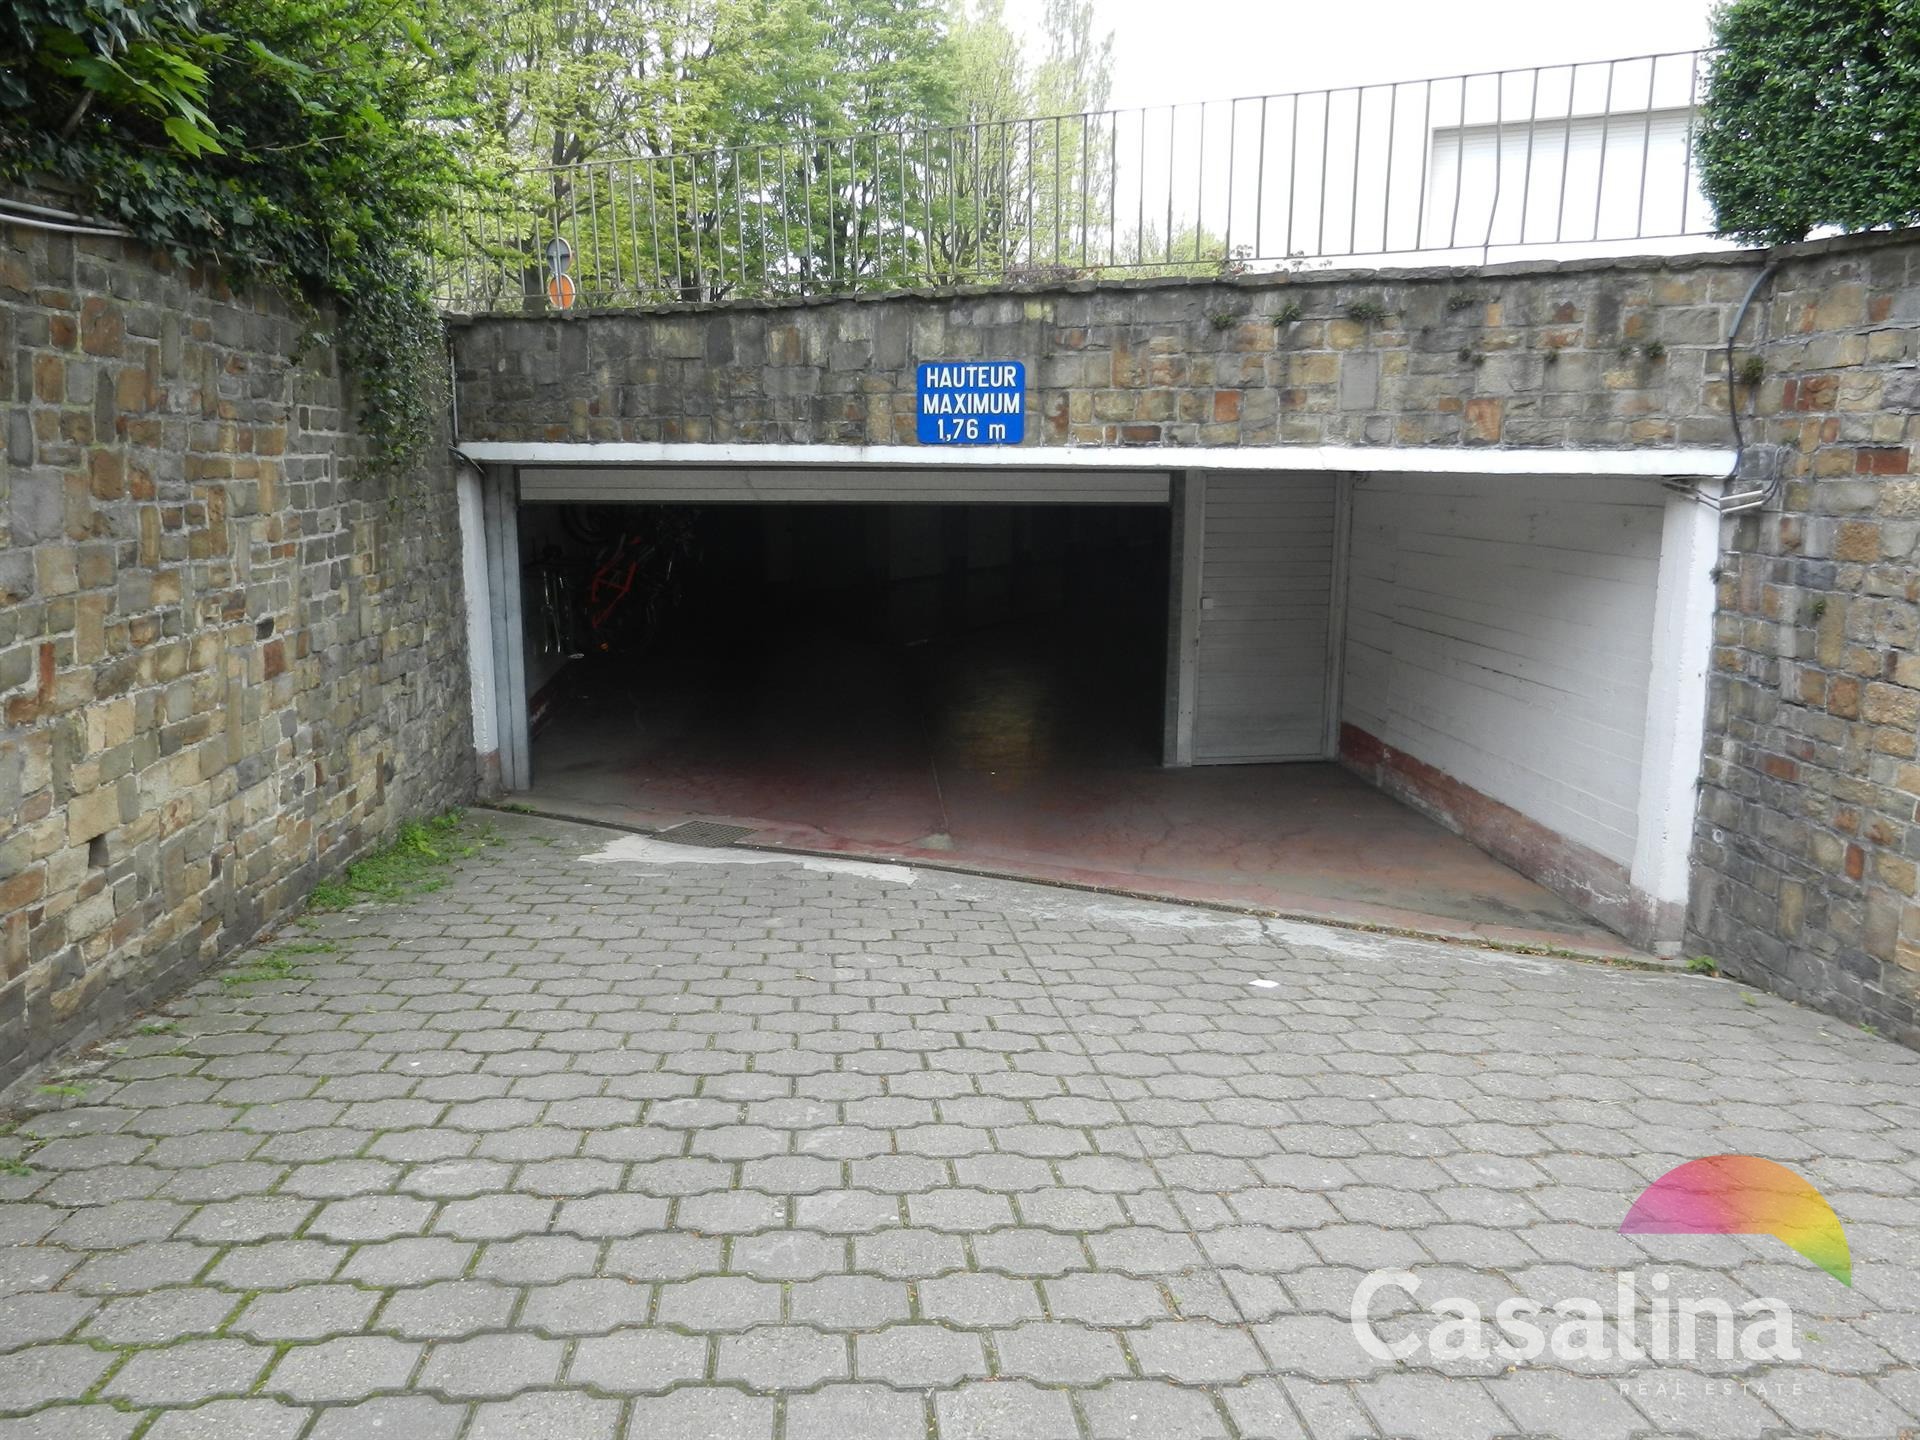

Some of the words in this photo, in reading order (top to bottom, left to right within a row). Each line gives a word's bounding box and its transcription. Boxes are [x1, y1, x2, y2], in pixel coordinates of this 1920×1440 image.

[926, 366, 1017, 388] HAUTEUR
[923, 393, 1020, 414] MAXIMUM
[937, 418, 979, 441] 1,76
[988, 424, 1006, 440] m
